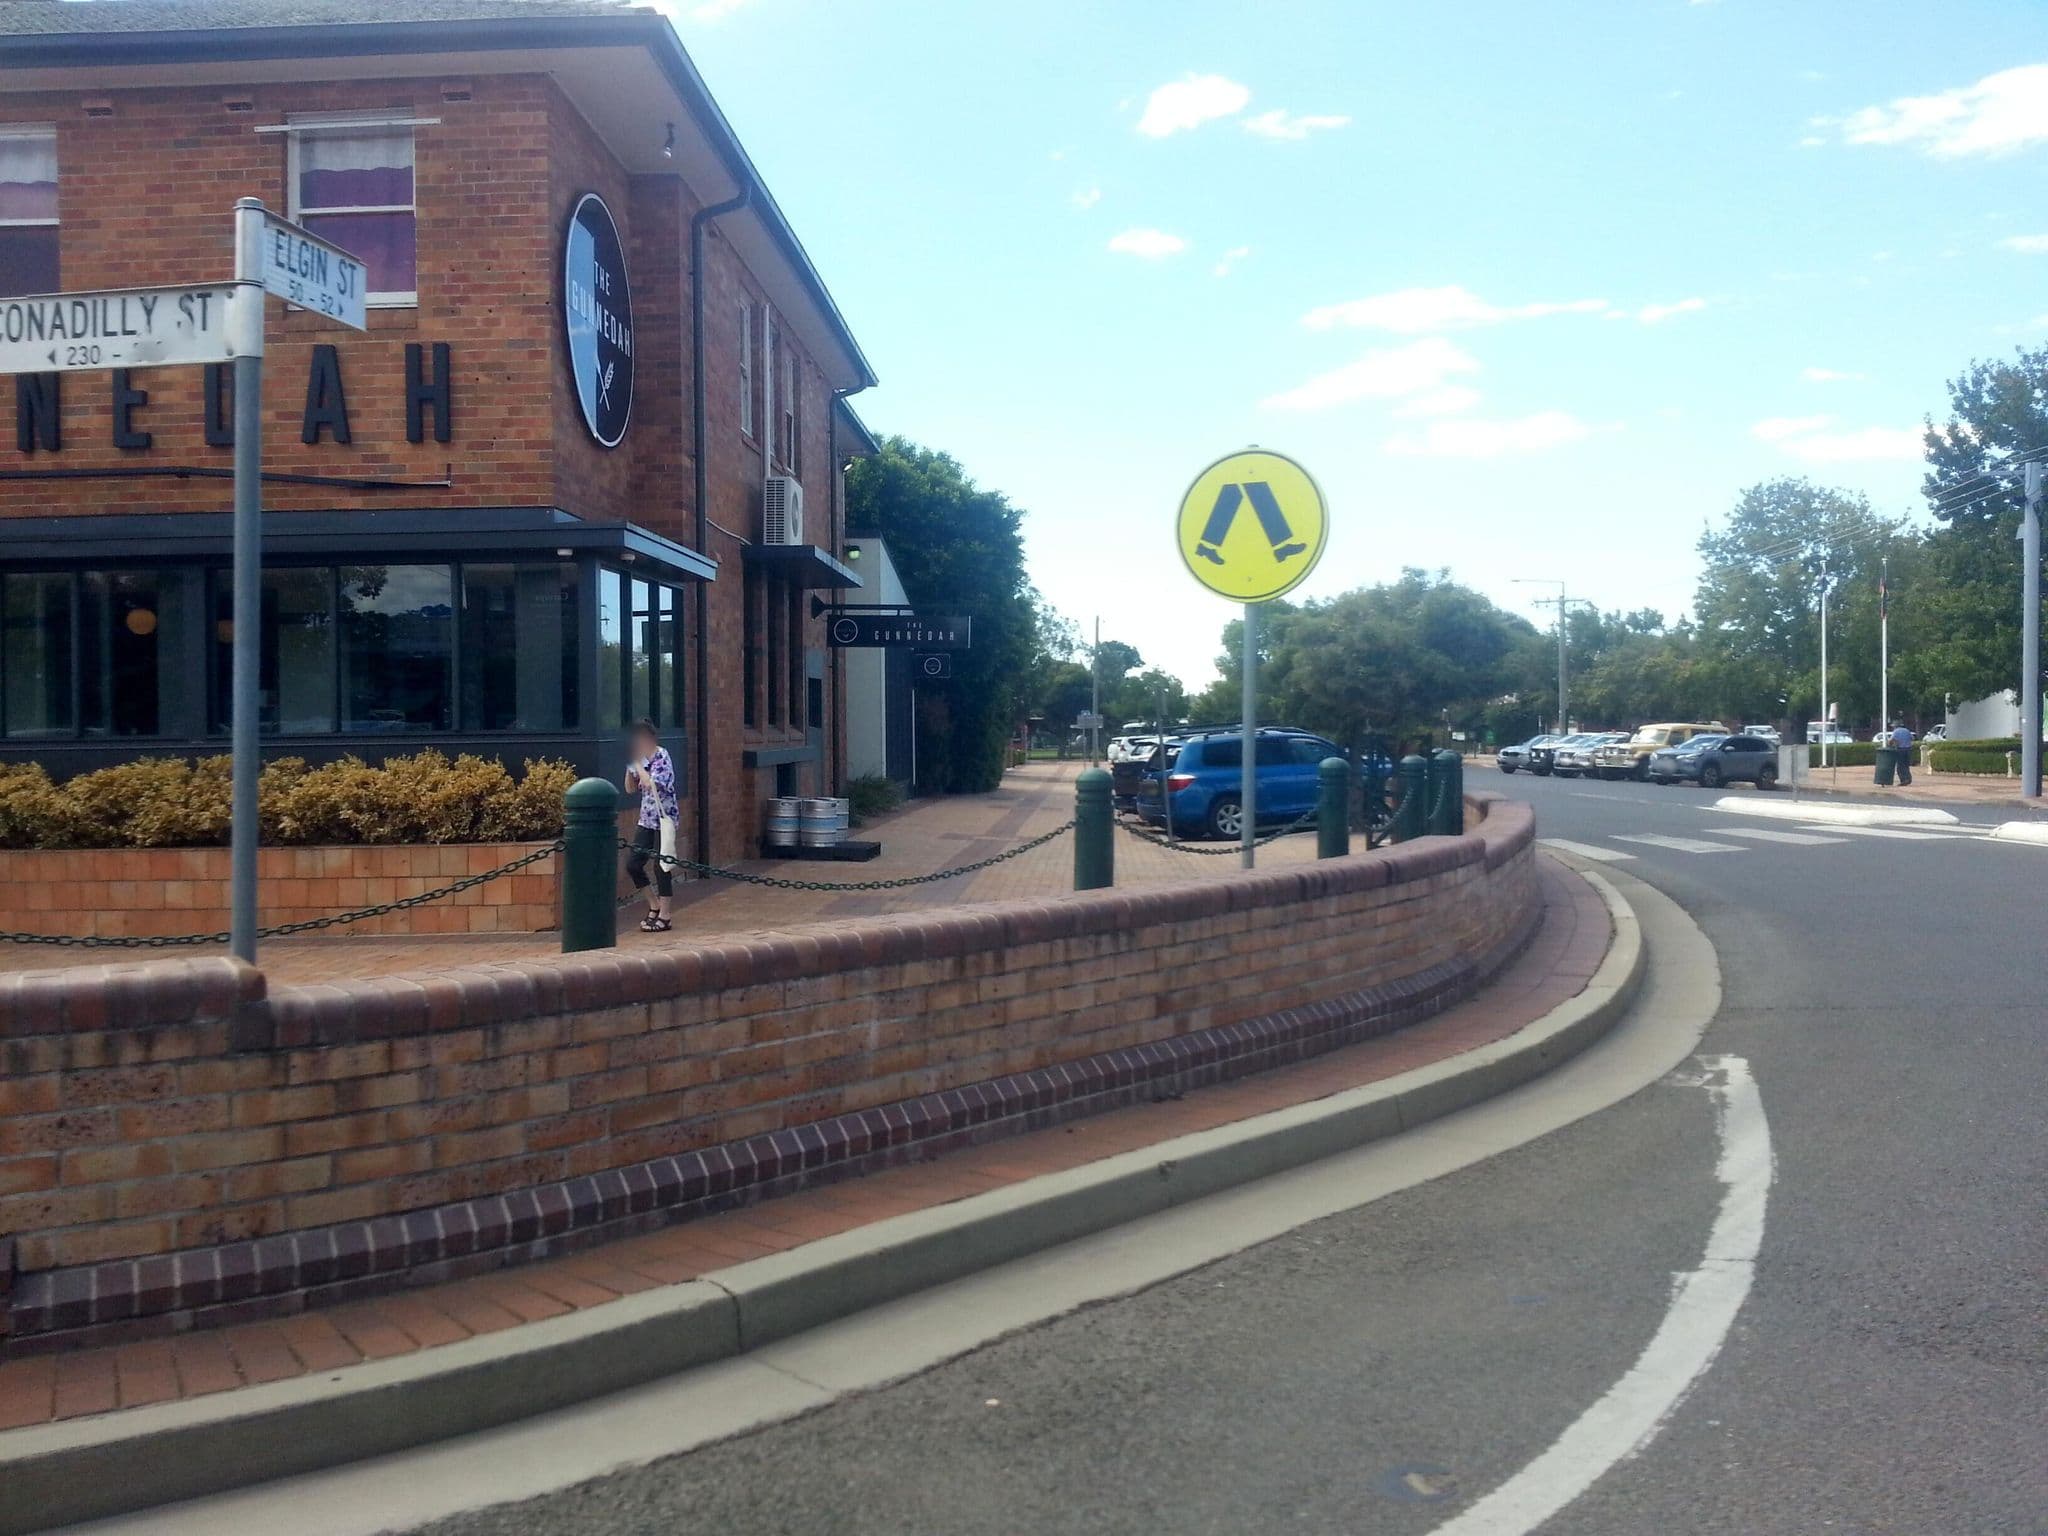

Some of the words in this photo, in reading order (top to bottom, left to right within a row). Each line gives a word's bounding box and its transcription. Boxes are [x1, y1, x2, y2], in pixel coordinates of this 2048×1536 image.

[275, 228, 328, 287] ELGIN
[337, 259, 357, 299] ST
[594, 261, 611, 297] THE
[0, 295, 159, 343] ONADILLY
[177, 292, 212, 333] ST
[321, 293, 334, 315] 52
[572, 279, 631, 358] GUNNEDAH
[66, 345, 101, 366] 230
[874, 630, 955, 641] GUNNEDAH
